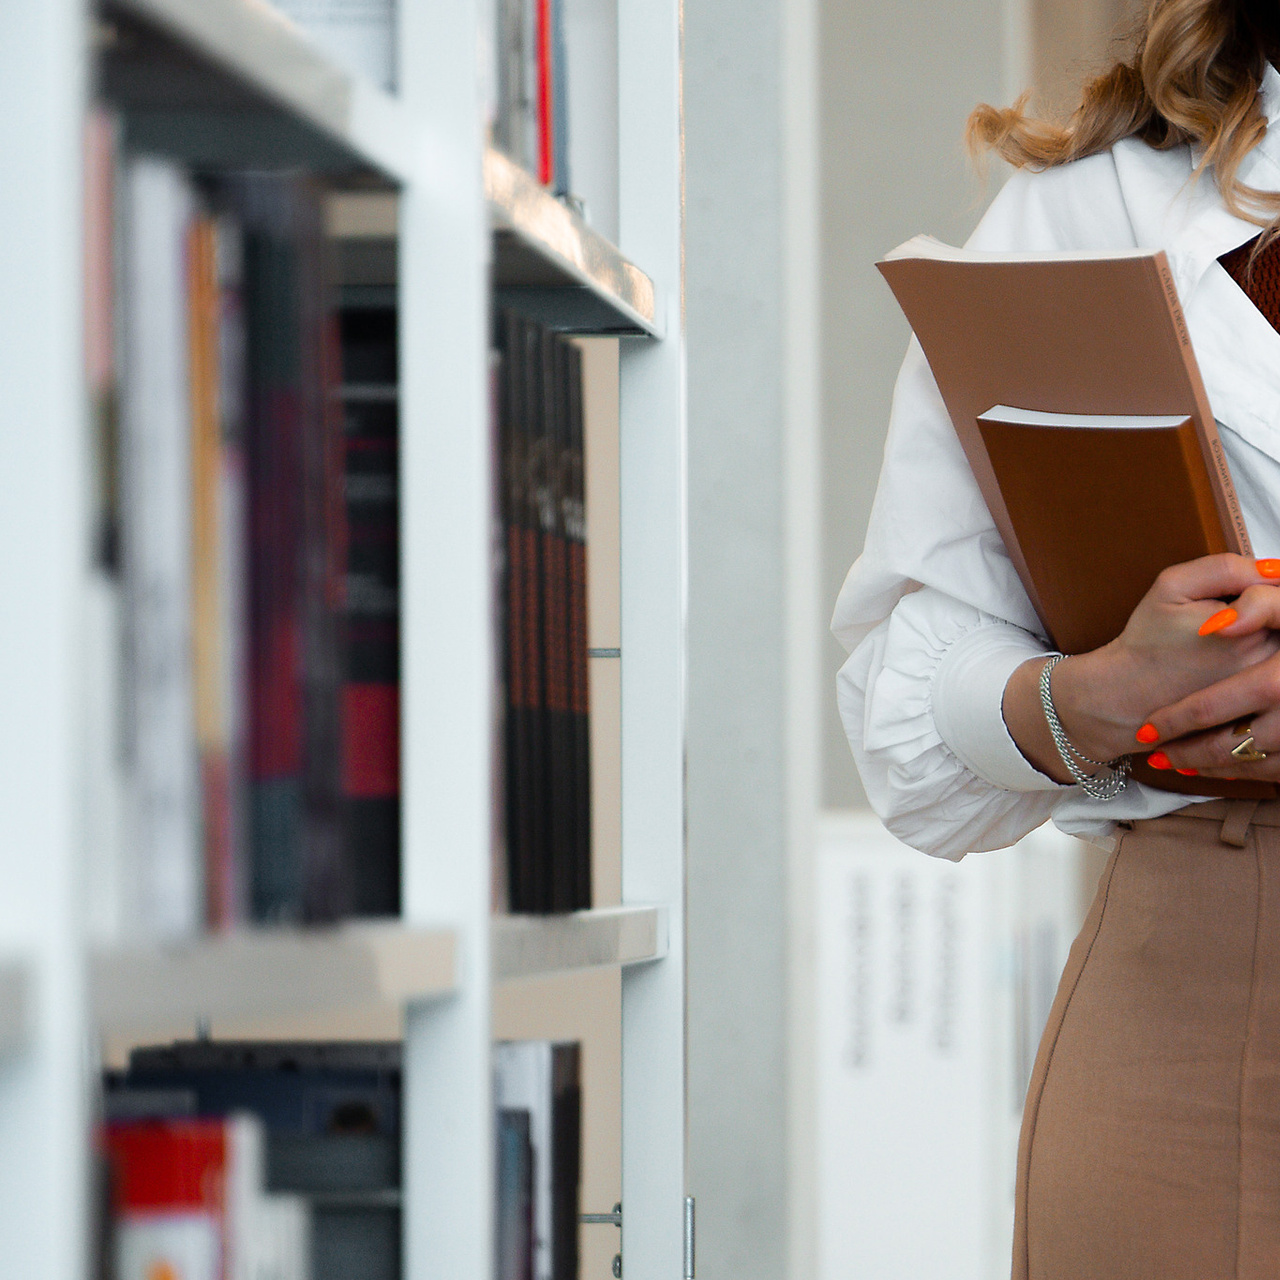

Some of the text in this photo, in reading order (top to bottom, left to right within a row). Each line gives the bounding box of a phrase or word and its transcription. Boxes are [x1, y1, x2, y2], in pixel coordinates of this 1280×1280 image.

[1161, 266, 1189, 346] GARDA DECOR
[1211, 438, 1230, 487] ВОЗЬМИТЕ
[1226, 488, 1239, 513] ЭТОТ
